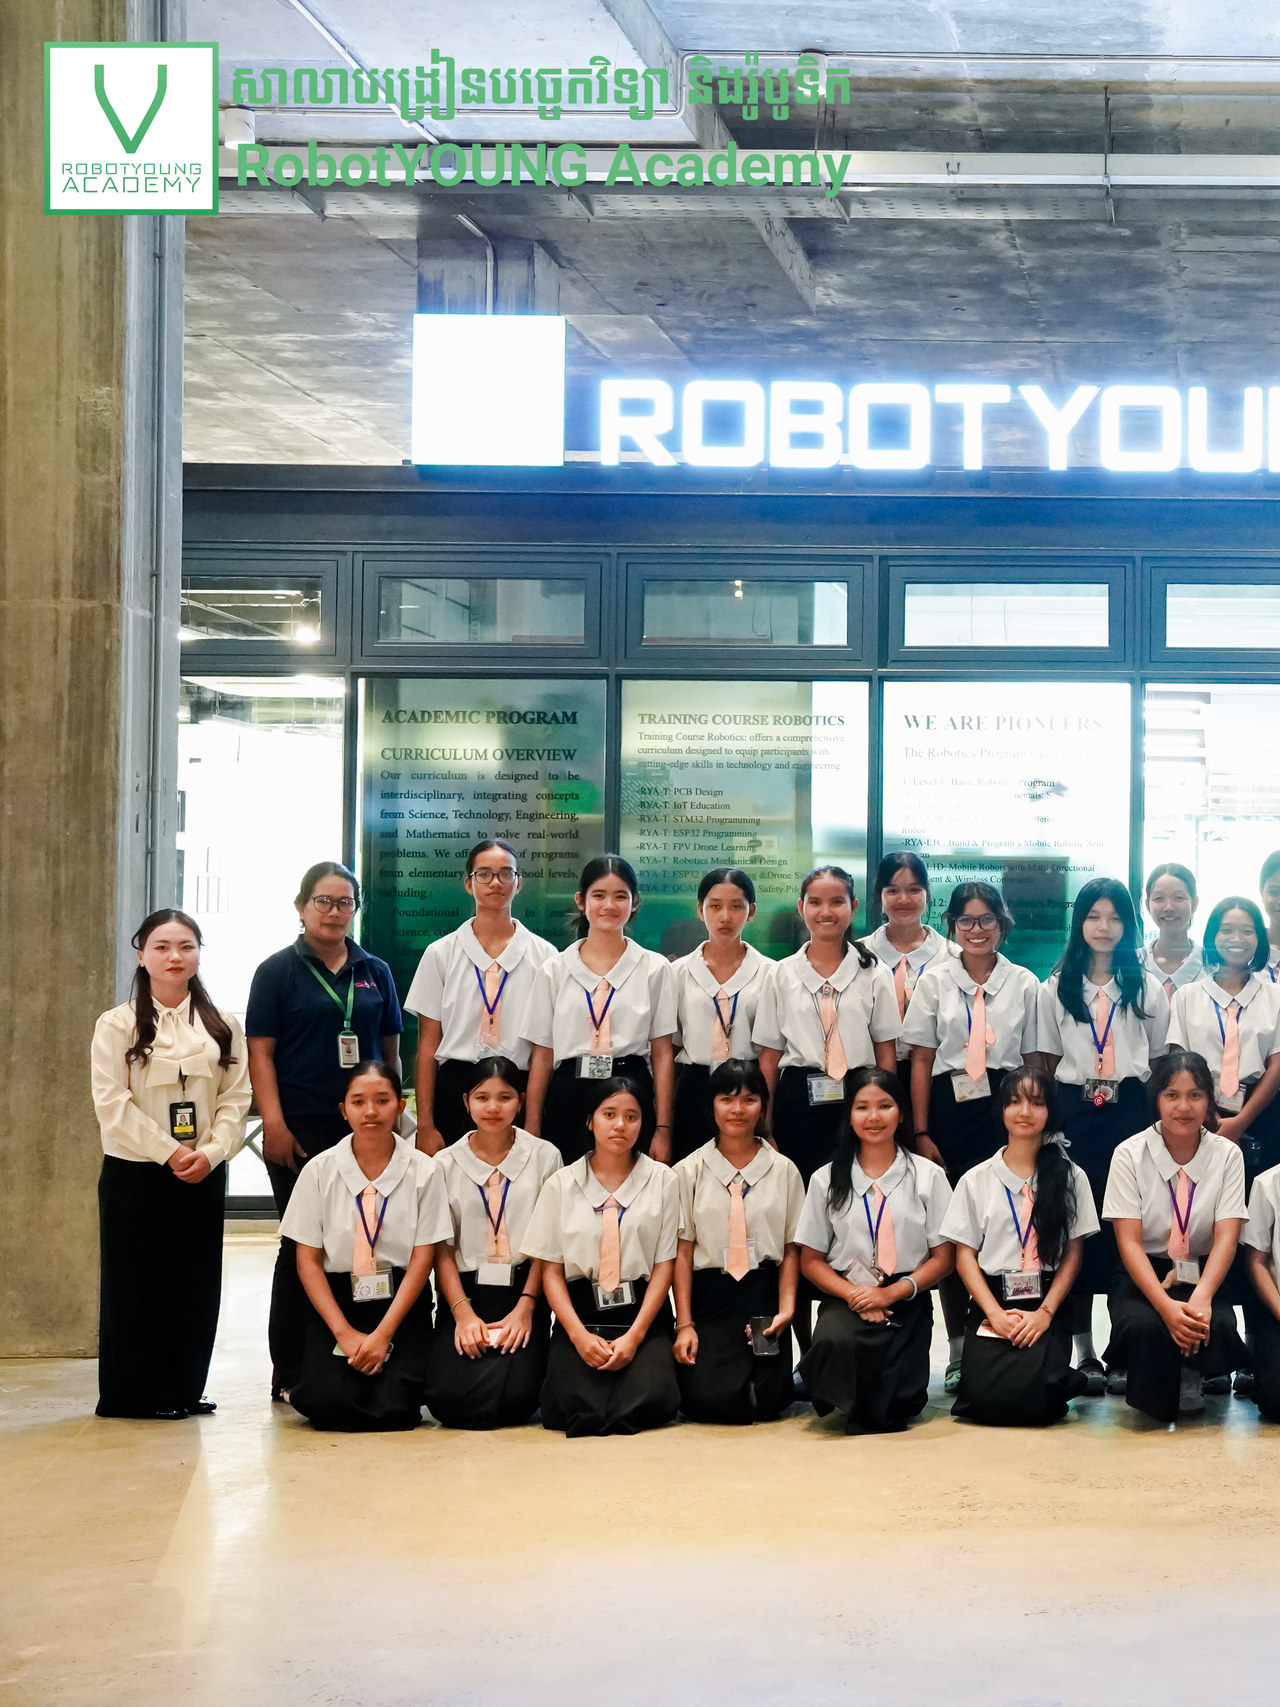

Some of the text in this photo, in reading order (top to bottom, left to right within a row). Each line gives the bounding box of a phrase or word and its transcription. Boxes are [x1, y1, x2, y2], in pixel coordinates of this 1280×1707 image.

[381, 710, 578, 725] ACADEMIC PROGRAM
[638, 714, 845, 726] TRAINING COURSE ROBOTICS
[945, 715, 988, 731] ARE
[638, 732, 673, 742] Training
[676, 732, 705, 742] Course
[708, 732, 746, 742] Robotics:
[750, 732, 774, 742] offers
[783, 733, 845, 744] comprehensive
[381, 748, 577, 761] CURRICULUM OVERVIEW
[637, 746, 683, 755] curriculum
[685, 746, 722, 757] designed
[735, 746, 758, 757] equip
[760, 746, 810, 757] participants
[904, 747, 924, 759] The
[928, 747, 976, 759] Robotics
[692, 760, 714, 769] skills
[726, 760, 772, 772] technology
[774, 761, 790, 769] and
[381, 770, 401, 780] Our
[411, 770, 467, 780] curriculum
[494, 770, 539, 783] designed
[381, 790, 580, 802] interdisciplinary, integrating concepts
[674, 788, 692, 796] PCB
[695, 788, 723, 798] Design
[674, 802, 688, 810] IoT
[690, 802, 730, 810] Education
[380, 809, 579, 822] from Science, Technology, Engineering,
[673, 816, 704, 824] STM32
[706, 816, 761, 826] Programming
[380, 830, 398, 839] and
[406, 830, 470, 839] Mathematics
[494, 830, 520, 839] solve
[527, 830, 579, 839] real-world
[673, 829, 700, 837] ESP32
[702, 830, 758, 840] Programming
[673, 843, 692, 851] FPV
[694, 843, 718, 851] Drone
[721, 843, 757, 854] Learning
[949, 839, 970, 848] Build
[982, 840, 1015, 849] Program
[1024, 839, 1051, 848] Mobile
[1054, 839, 1084, 848] Robotic
[380, 849, 428, 860] problems.
[531, 851, 579, 861] programs
[673, 857, 708, 865] Robotics
[710, 857, 758, 865] Mechanical
[760, 857, 788, 868] Design
[949, 864, 977, 872] Mobile
[979, 864, 1006, 872] Robots
[1008, 864, 1026, 872] with
[408, 869, 464, 881] elementary
[548, 869, 579, 879] levels,
[758, 884, 785, 896] Safety
